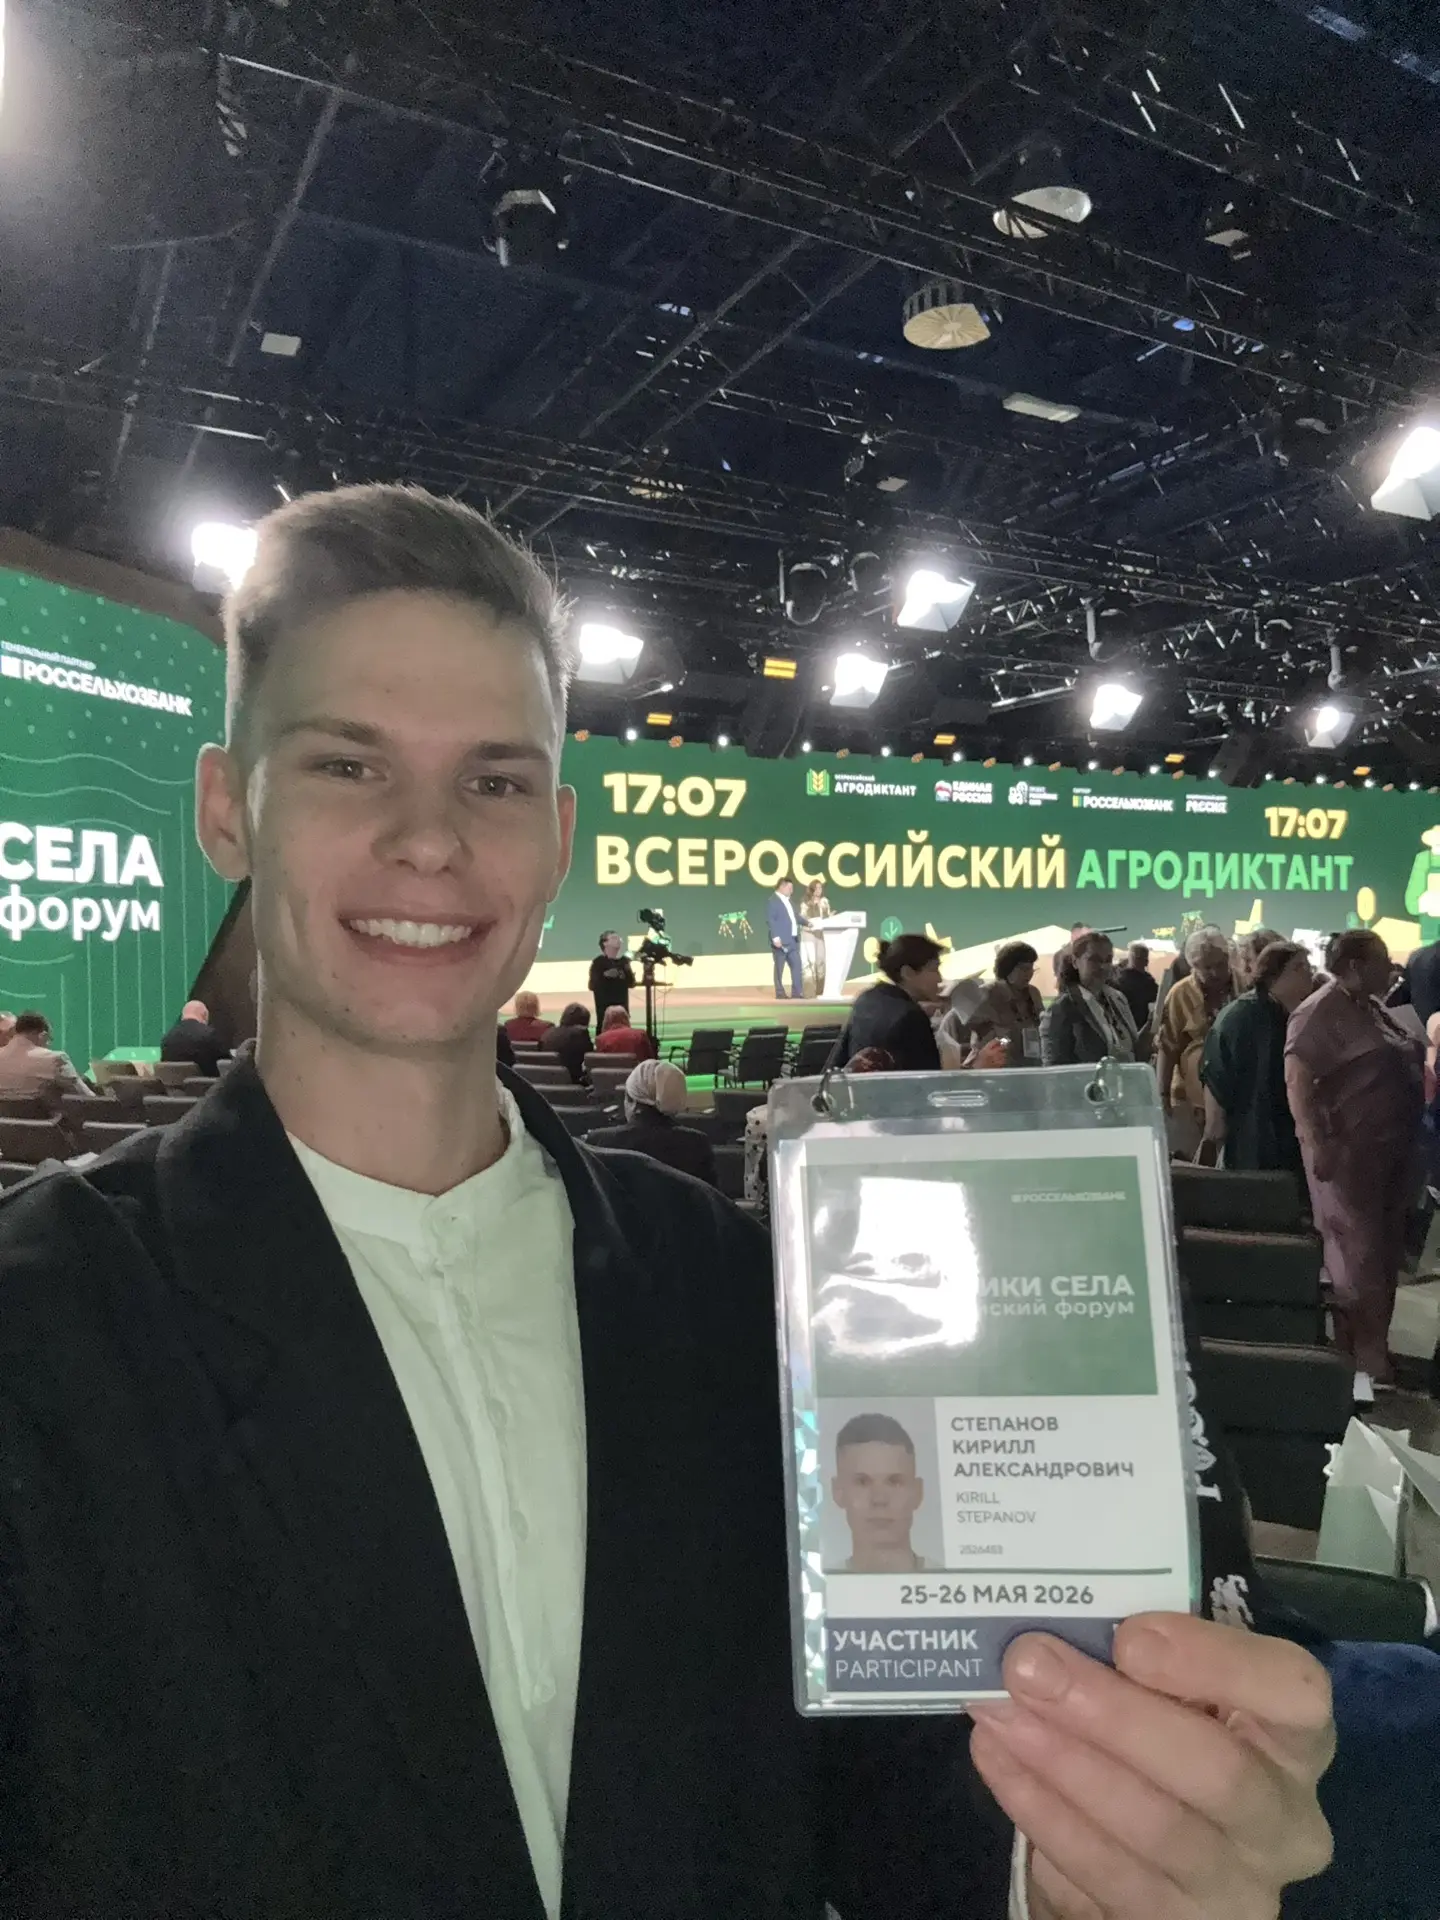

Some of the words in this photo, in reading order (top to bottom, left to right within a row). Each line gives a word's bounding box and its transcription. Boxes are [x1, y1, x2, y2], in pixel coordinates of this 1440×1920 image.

[23, 659, 193, 717] РОССЕЛЬХОЗБАНК
[603, 772, 747, 818] 17:07
[834, 781, 917, 797] АГРОДИКТАНТ
[1264, 806, 1348, 840] 17:07
[0, 821, 164, 887] СЕЛА
[596, 829, 1065, 889] ВСЕРОССИЙСКИЙ
[1076, 849, 1353, 898] АГРОДИКТАНТ
[0, 884, 160, 941] форум
[1050, 1274, 1135, 1297] СЕЛА
[1055, 1297, 1134, 1320] форум
[951, 1417, 1058, 1432] СТЕПАНОВ
[953, 1440, 1035, 1454] КИРИЛЛ
[954, 1462, 1134, 1480] АЛЕКСАНДРОВИЧ
[956, 1491, 999, 1504] KIRILL
[957, 1511, 1036, 1524] STEPANOV
[900, 1585, 966, 1604] 25-26
[974, 1585, 1027, 1603] МАЯ
[1034, 1585, 1094, 1604] 2026
[834, 1629, 978, 1651] УЧАСТНИК
[835, 1659, 983, 1678] PARTICIPANT
